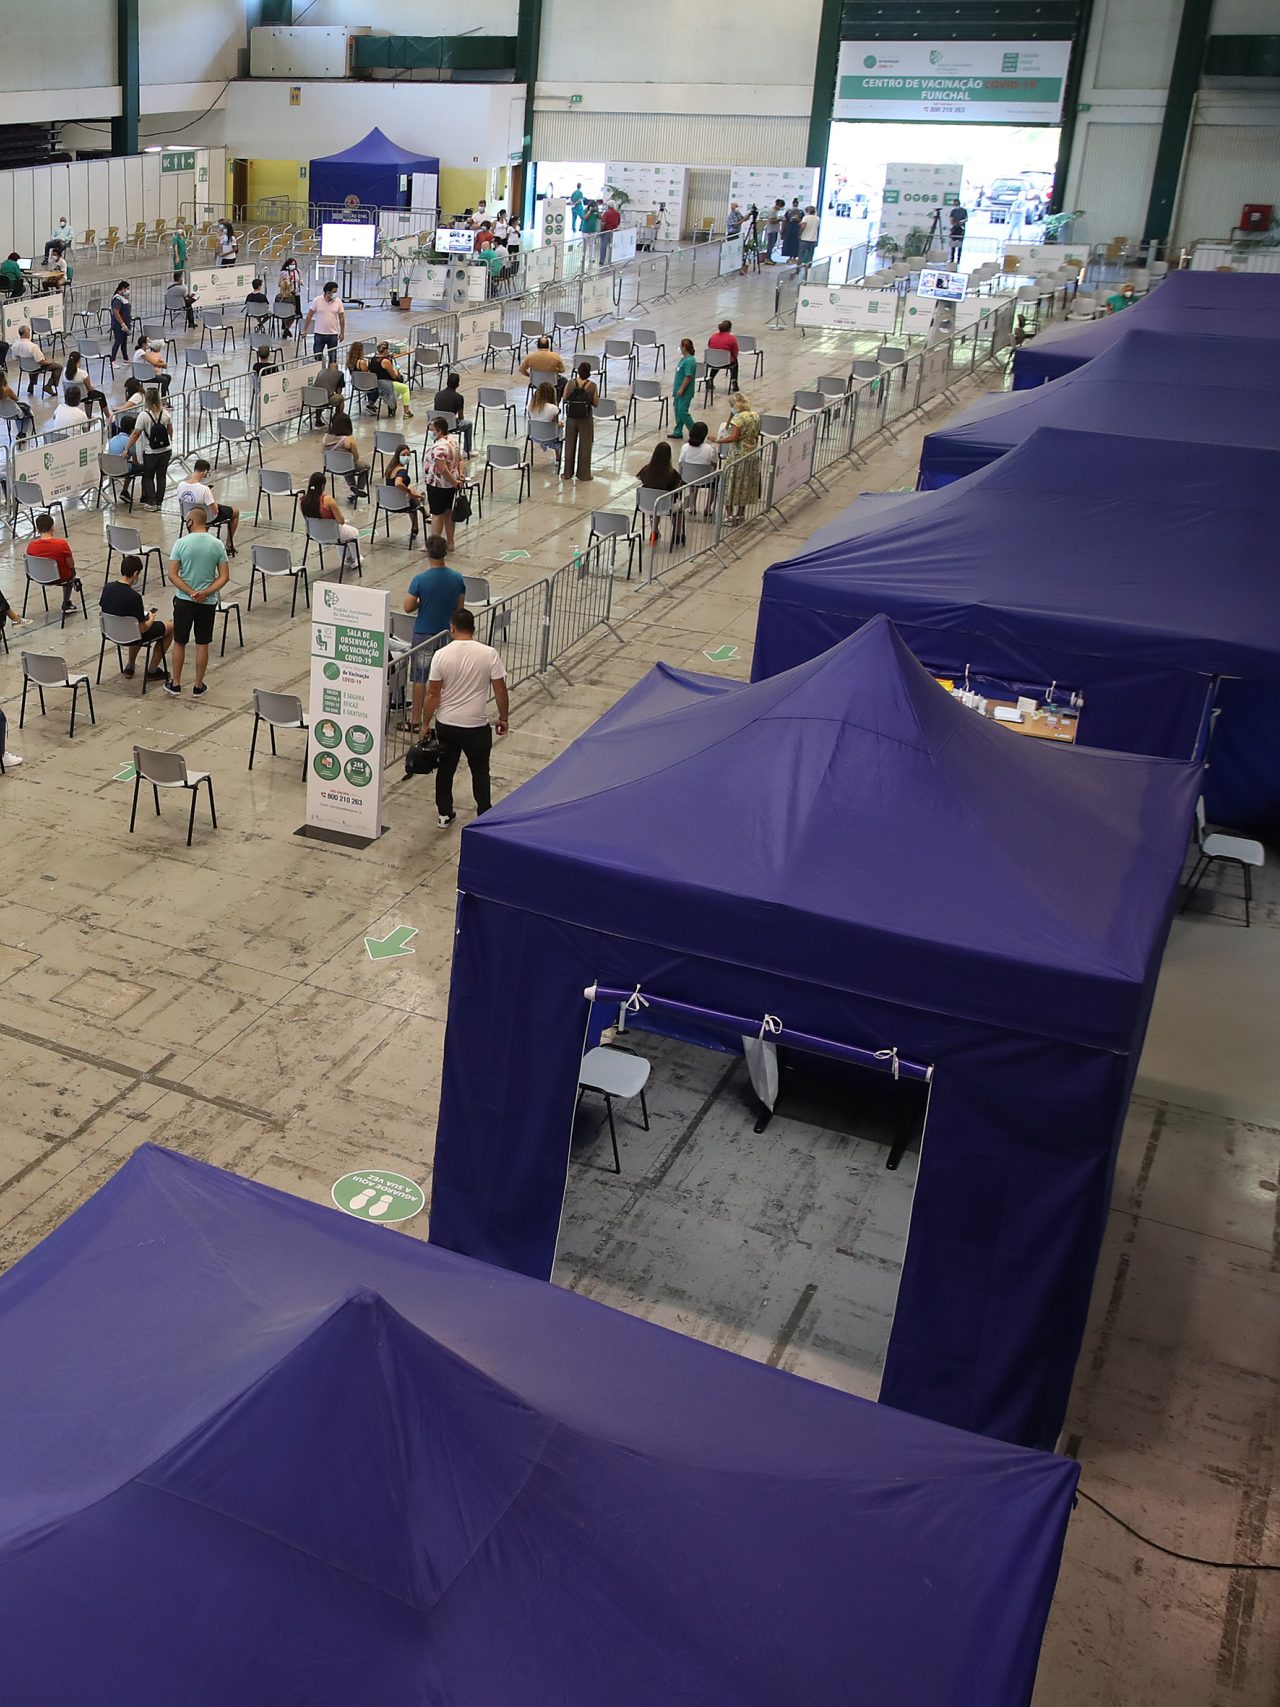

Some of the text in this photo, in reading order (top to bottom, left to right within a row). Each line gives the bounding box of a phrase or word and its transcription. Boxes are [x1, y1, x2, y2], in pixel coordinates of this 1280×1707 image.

[862, 78, 903, 88] CENTRO
[905, 79, 919, 88] DE
[921, 78, 983, 91] VACINAÇÃO
[921, 91, 971, 100] FUNCHAL
[346, 629, 361, 637] SALA
[340, 636, 378, 649] OBSERVAÇÃO
[338, 644, 380, 658] PÓS VACINAÇÃO
[344, 654, 372, 665] COVID-19
[348, 671, 370, 680] Vacinação
[342, 677, 362, 685] COVID-19
[327, 793, 363, 806] 800 210 263
[367, 1174, 385, 1184] VEZ
[352, 1175, 419, 1201] AGUARDE AQUI
[386, 1181, 405, 1190] SUA
